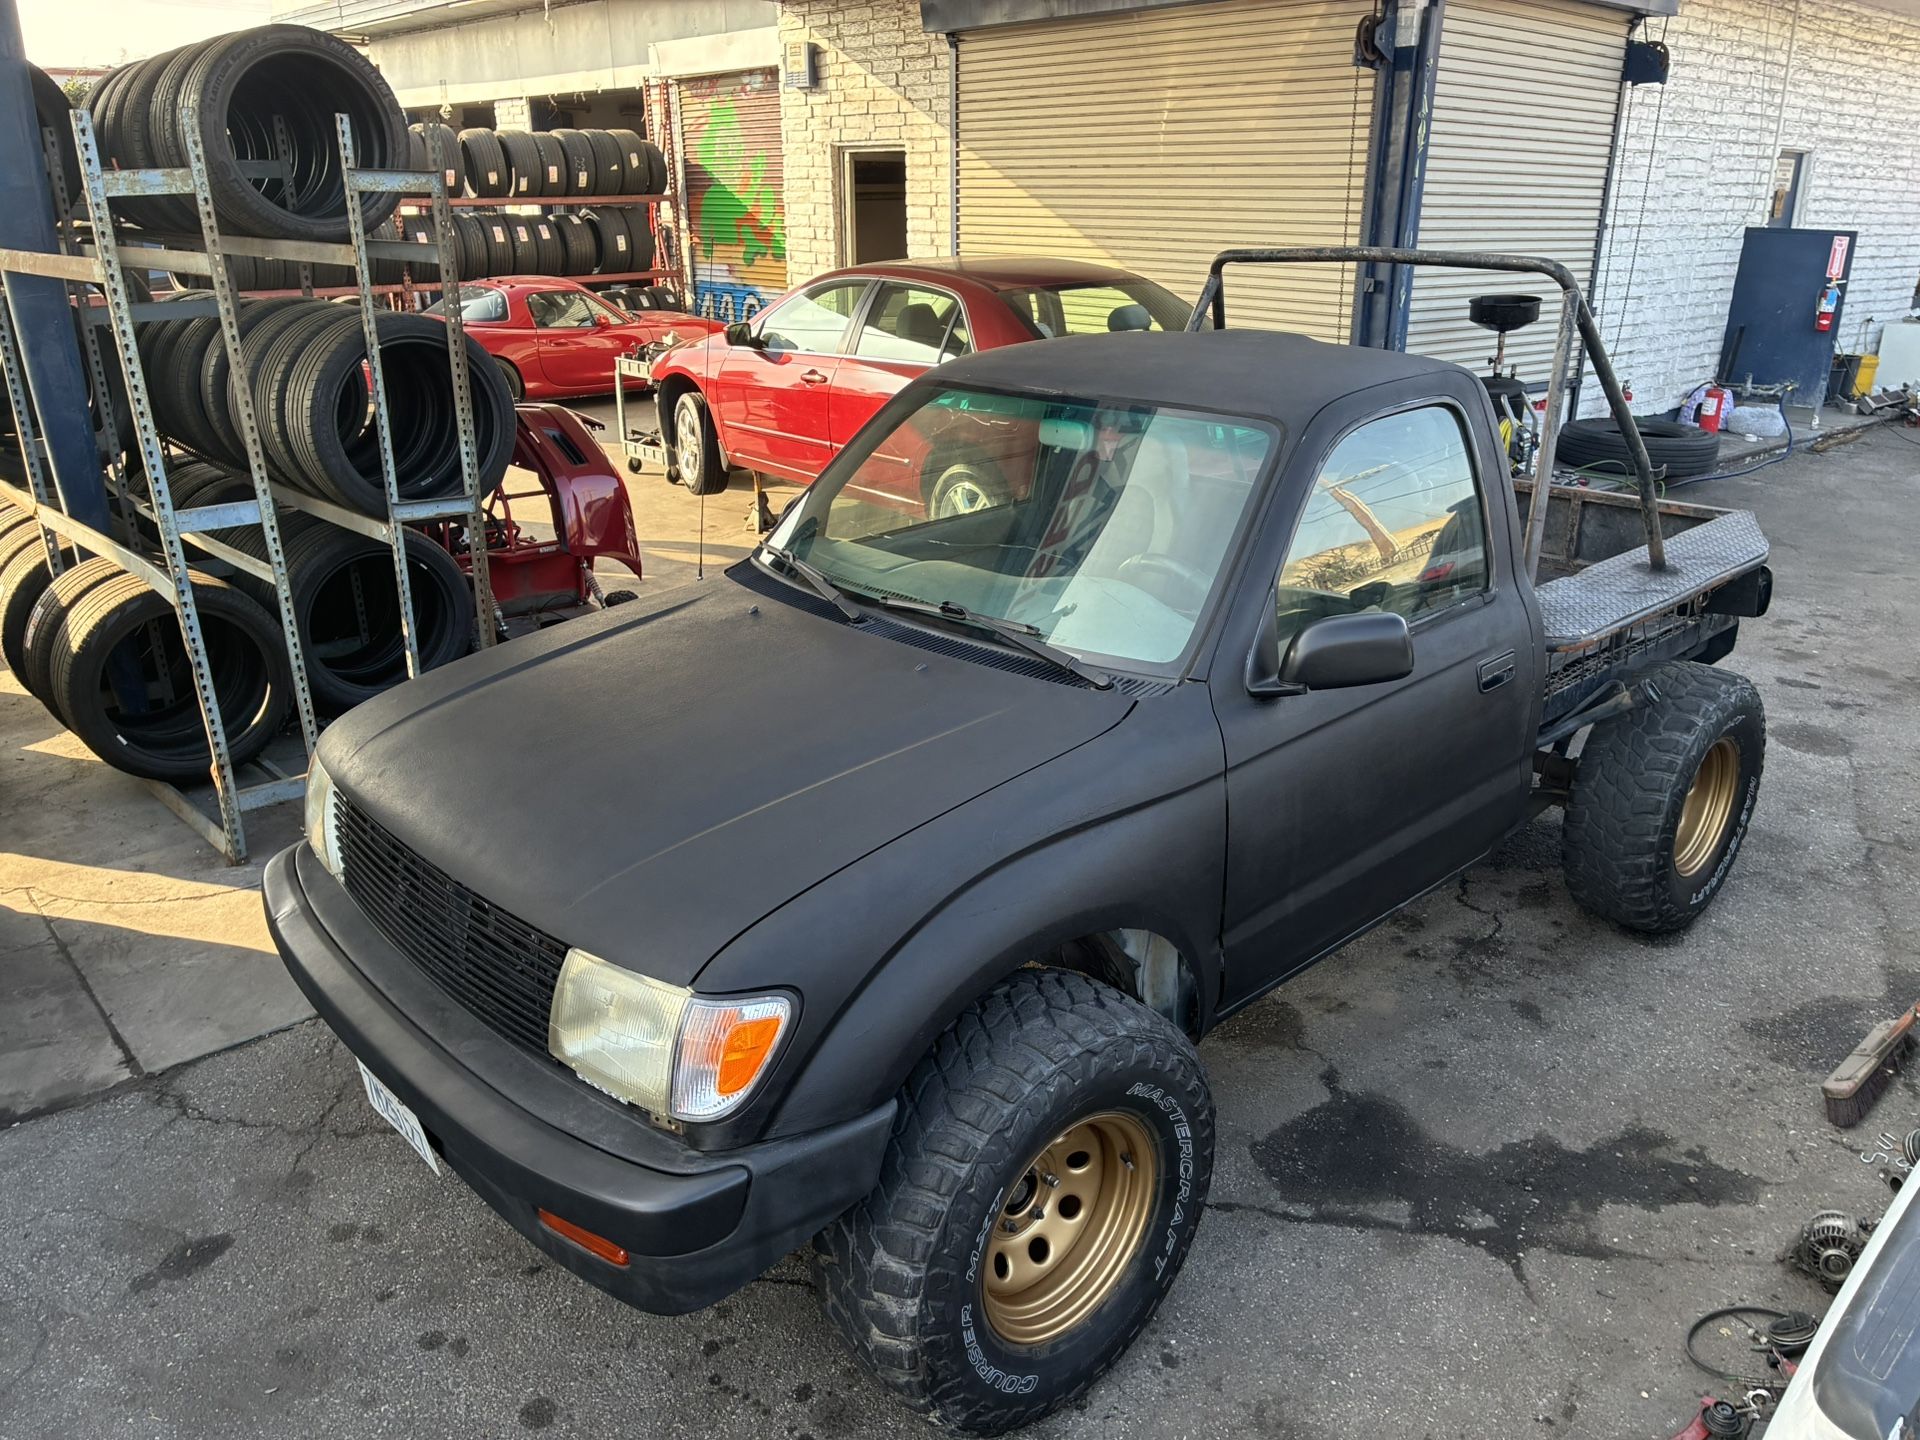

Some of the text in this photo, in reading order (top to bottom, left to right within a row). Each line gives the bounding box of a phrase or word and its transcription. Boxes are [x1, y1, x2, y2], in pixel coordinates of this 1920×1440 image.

[1690, 776, 1756, 905] MASTERCRAFT
[966, 1187, 1004, 1283] MXT
[1127, 1082, 1192, 1281] MASTERCRAFT
[961, 1303, 1040, 1394] COURSER
